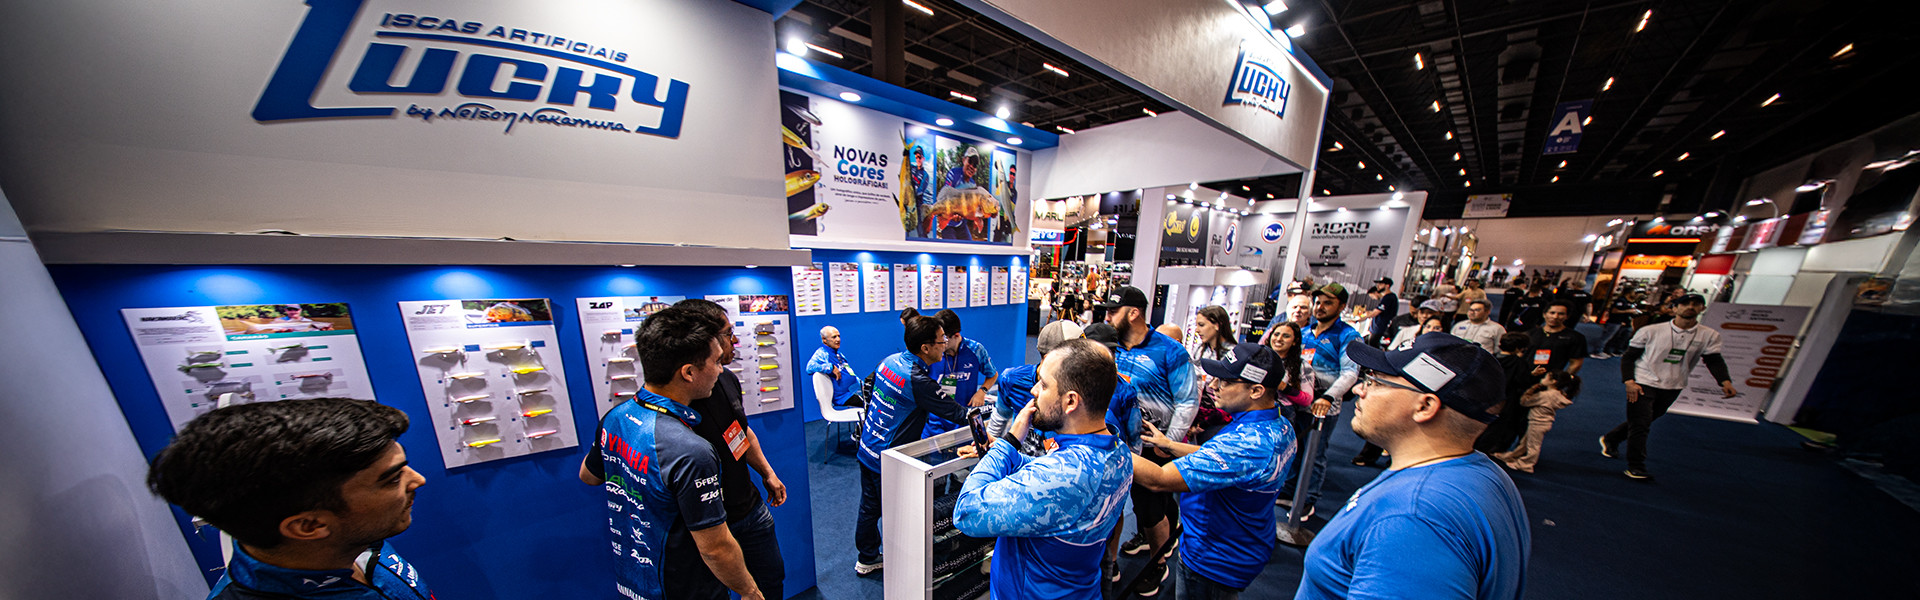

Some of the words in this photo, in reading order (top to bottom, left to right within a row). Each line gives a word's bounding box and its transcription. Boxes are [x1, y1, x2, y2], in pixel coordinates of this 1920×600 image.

[380, 13, 483, 34] ISCAS
[486, 25, 629, 63] ARTIFICIAIS
[406, 103, 434, 121] by
[438, 102, 518, 135] Nelson
[519, 107, 631, 133] Nakamura
[1549, 111, 1582, 137] A
[833, 145, 889, 168] NOVAS
[837, 158, 885, 181] Cores
[1312, 221, 1371, 235] MORO
[1320, 245, 1340, 255] F3
[1367, 245, 1391, 257] F3
[1625, 257, 1657, 266] Made
[1660, 258, 1678, 267] for
[415, 304, 450, 315] JET
[589, 301, 613, 310] ZAP
[881, 364, 906, 389] YAMAHA
[608, 432, 650, 475] YAMAHA
